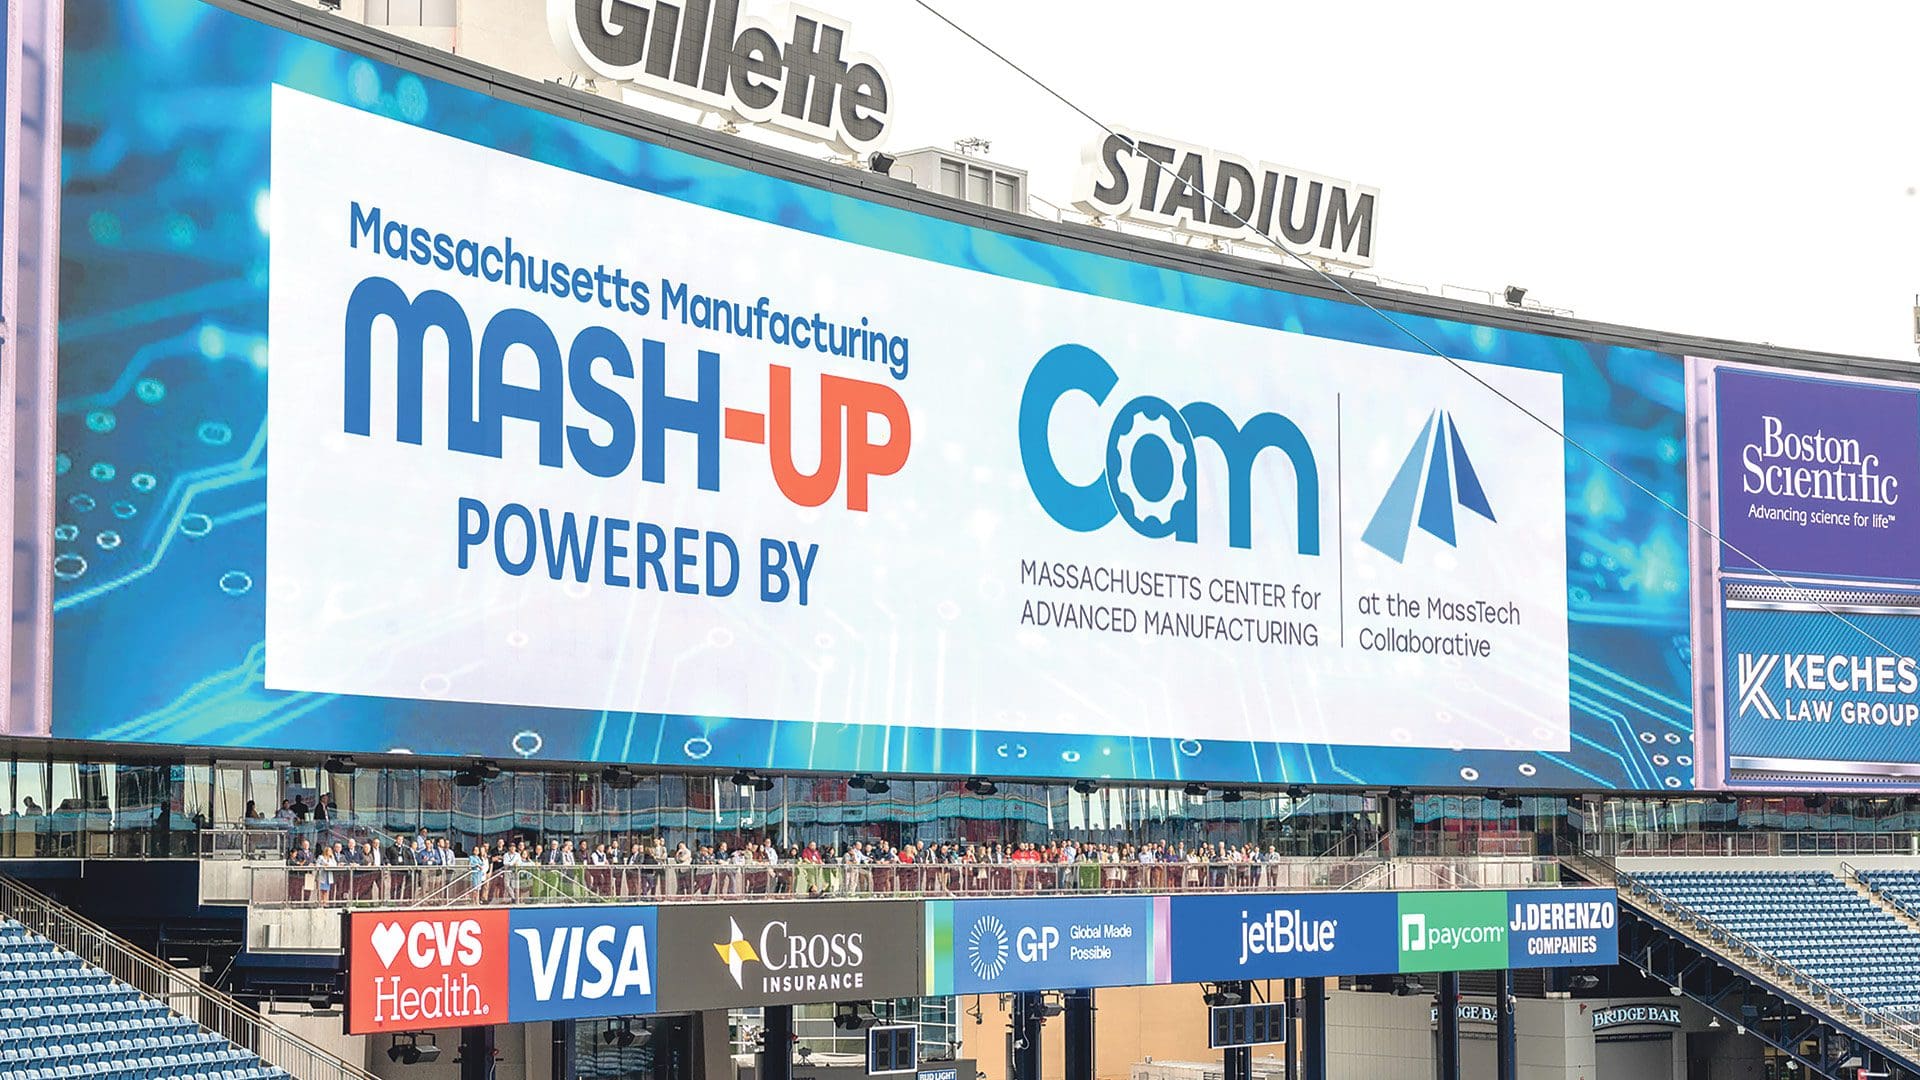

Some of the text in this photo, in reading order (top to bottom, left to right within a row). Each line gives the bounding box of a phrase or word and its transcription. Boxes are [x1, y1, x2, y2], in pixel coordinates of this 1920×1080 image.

[574, 0, 888, 142] Gillette
[1093, 132, 1375, 257] STADIUM
[350, 201, 909, 380] Massachusetts Manufacturing
[344, 276, 911, 512] MASH-UP
[1762, 416, 1861, 466] Boston
[1743, 444, 1898, 505] Scientific
[1748, 504, 1807, 526] Advancing
[1811, 510, 1850, 526] science
[1854, 512, 1869, 527] for
[458, 497, 819, 606] POWERED BY
[1021, 558, 1321, 610] MASSACHUSETTS CENTER for
[1021, 599, 1318, 647] ADVANCED MANUFACTURING
[1358, 592, 1520, 626] at the MassTech
[1359, 627, 1491, 658] Collaborative
[1784, 653, 1919, 694] KECHES
[1786, 698, 1919, 728] LAW GROUP
[407, 919, 483, 969] CVS
[1070, 924, 1132, 939] Global Made
[1070, 945, 1112, 960] Possible
[1528, 935, 1597, 955] COMPANIES
[513, 925, 652, 1001] VISA
[763, 972, 863, 993] INSURANCE
[1594, 1007, 1681, 1027] BRIDGE BAR
